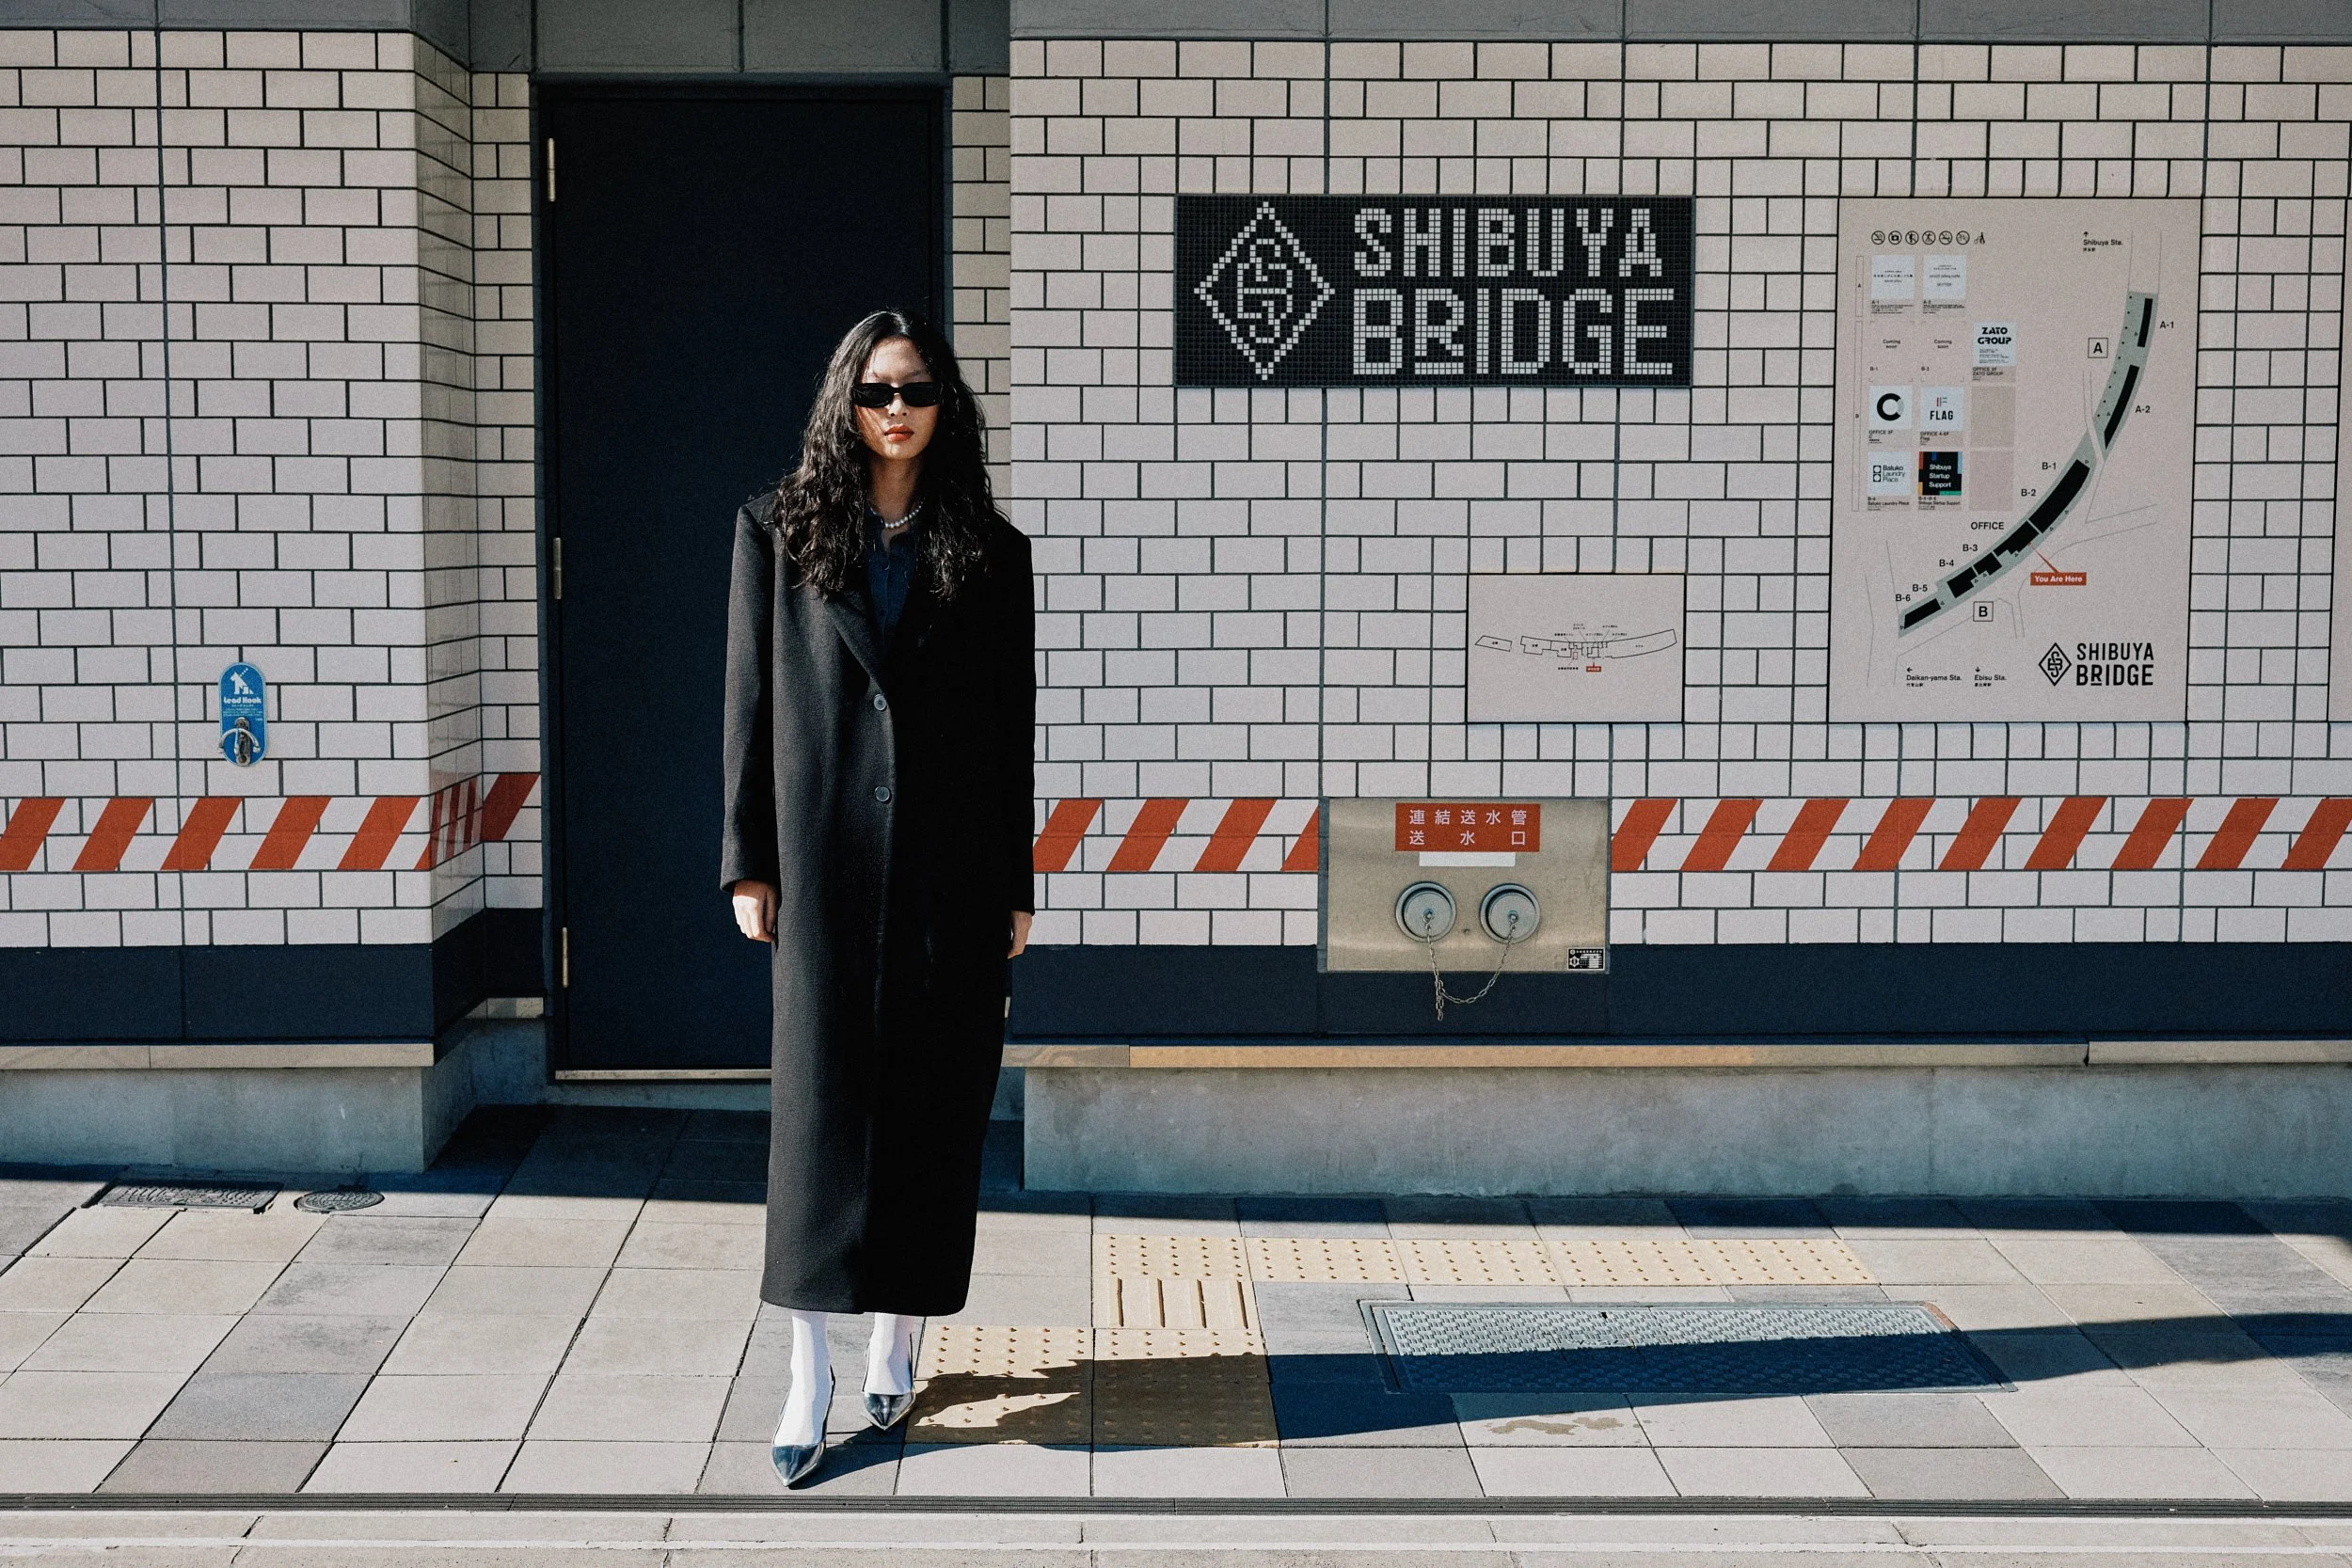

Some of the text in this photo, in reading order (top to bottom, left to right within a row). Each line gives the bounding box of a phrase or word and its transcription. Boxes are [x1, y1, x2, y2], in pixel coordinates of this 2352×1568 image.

[1354, 208, 1662, 277] SHIBUYA
[1353, 288, 1675, 375] BRIDGE
[1981, 326, 2008, 335] ZATO
[2093, 342, 2103, 354] A
[2136, 405, 2151, 414] A-2
[1930, 411, 1954, 420] FLAG
[2042, 462, 2057, 470] B-1
[1929, 472, 1950, 481] Startup
[1971, 521, 2005, 531] OFFICE
[1963, 544, 1979, 552] B-3
[1912, 584, 1928, 593] B-5
[1895, 594, 1911, 602] B-6
[1979, 606, 1988, 617] B
[2076, 642, 2154, 661] SHIBUYA
[2075, 664, 2154, 687] BRIDGE
[1409, 809, 1527, 826] 連結送水管
[1409, 830, 1526, 846] 送水口
